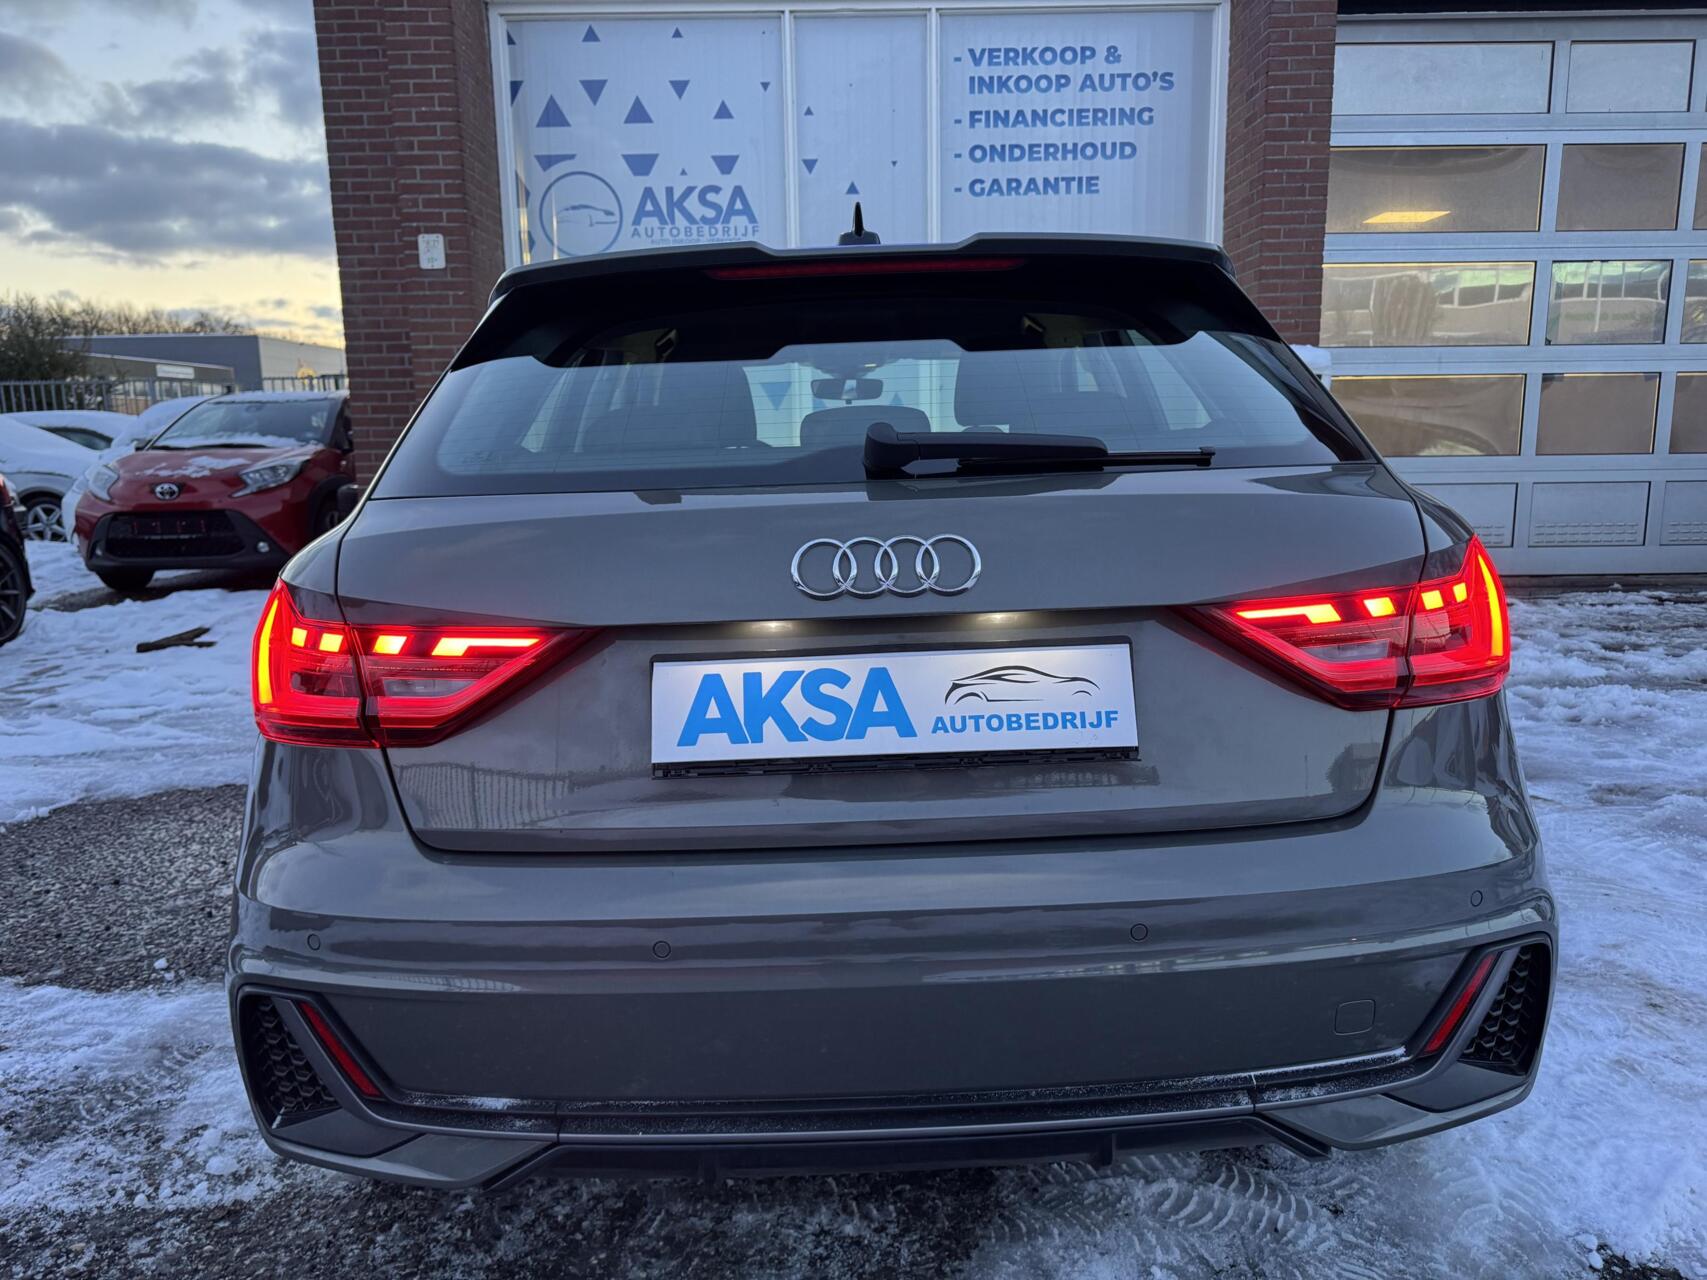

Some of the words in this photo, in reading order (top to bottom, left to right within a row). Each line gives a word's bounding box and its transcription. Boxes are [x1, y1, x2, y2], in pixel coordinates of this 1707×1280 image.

[968, 46, 1097, 67] VERKOOP
[1103, 45, 1122, 65] &
[968, 74, 1071, 95] INKOOP
[1078, 71, 1175, 93] AUTO'S
[968, 106, 1155, 129] FINANCIERING
[968, 141, 1138, 163] ONDERHOUD
[968, 175, 1100, 197] GARANTIE
[631, 184, 759, 227] AKSA
[630, 225, 760, 239] AUTOBEDRIJF
[676, 667, 918, 747] AKSA
[931, 709, 1119, 735] AUTOBEDRIJF
